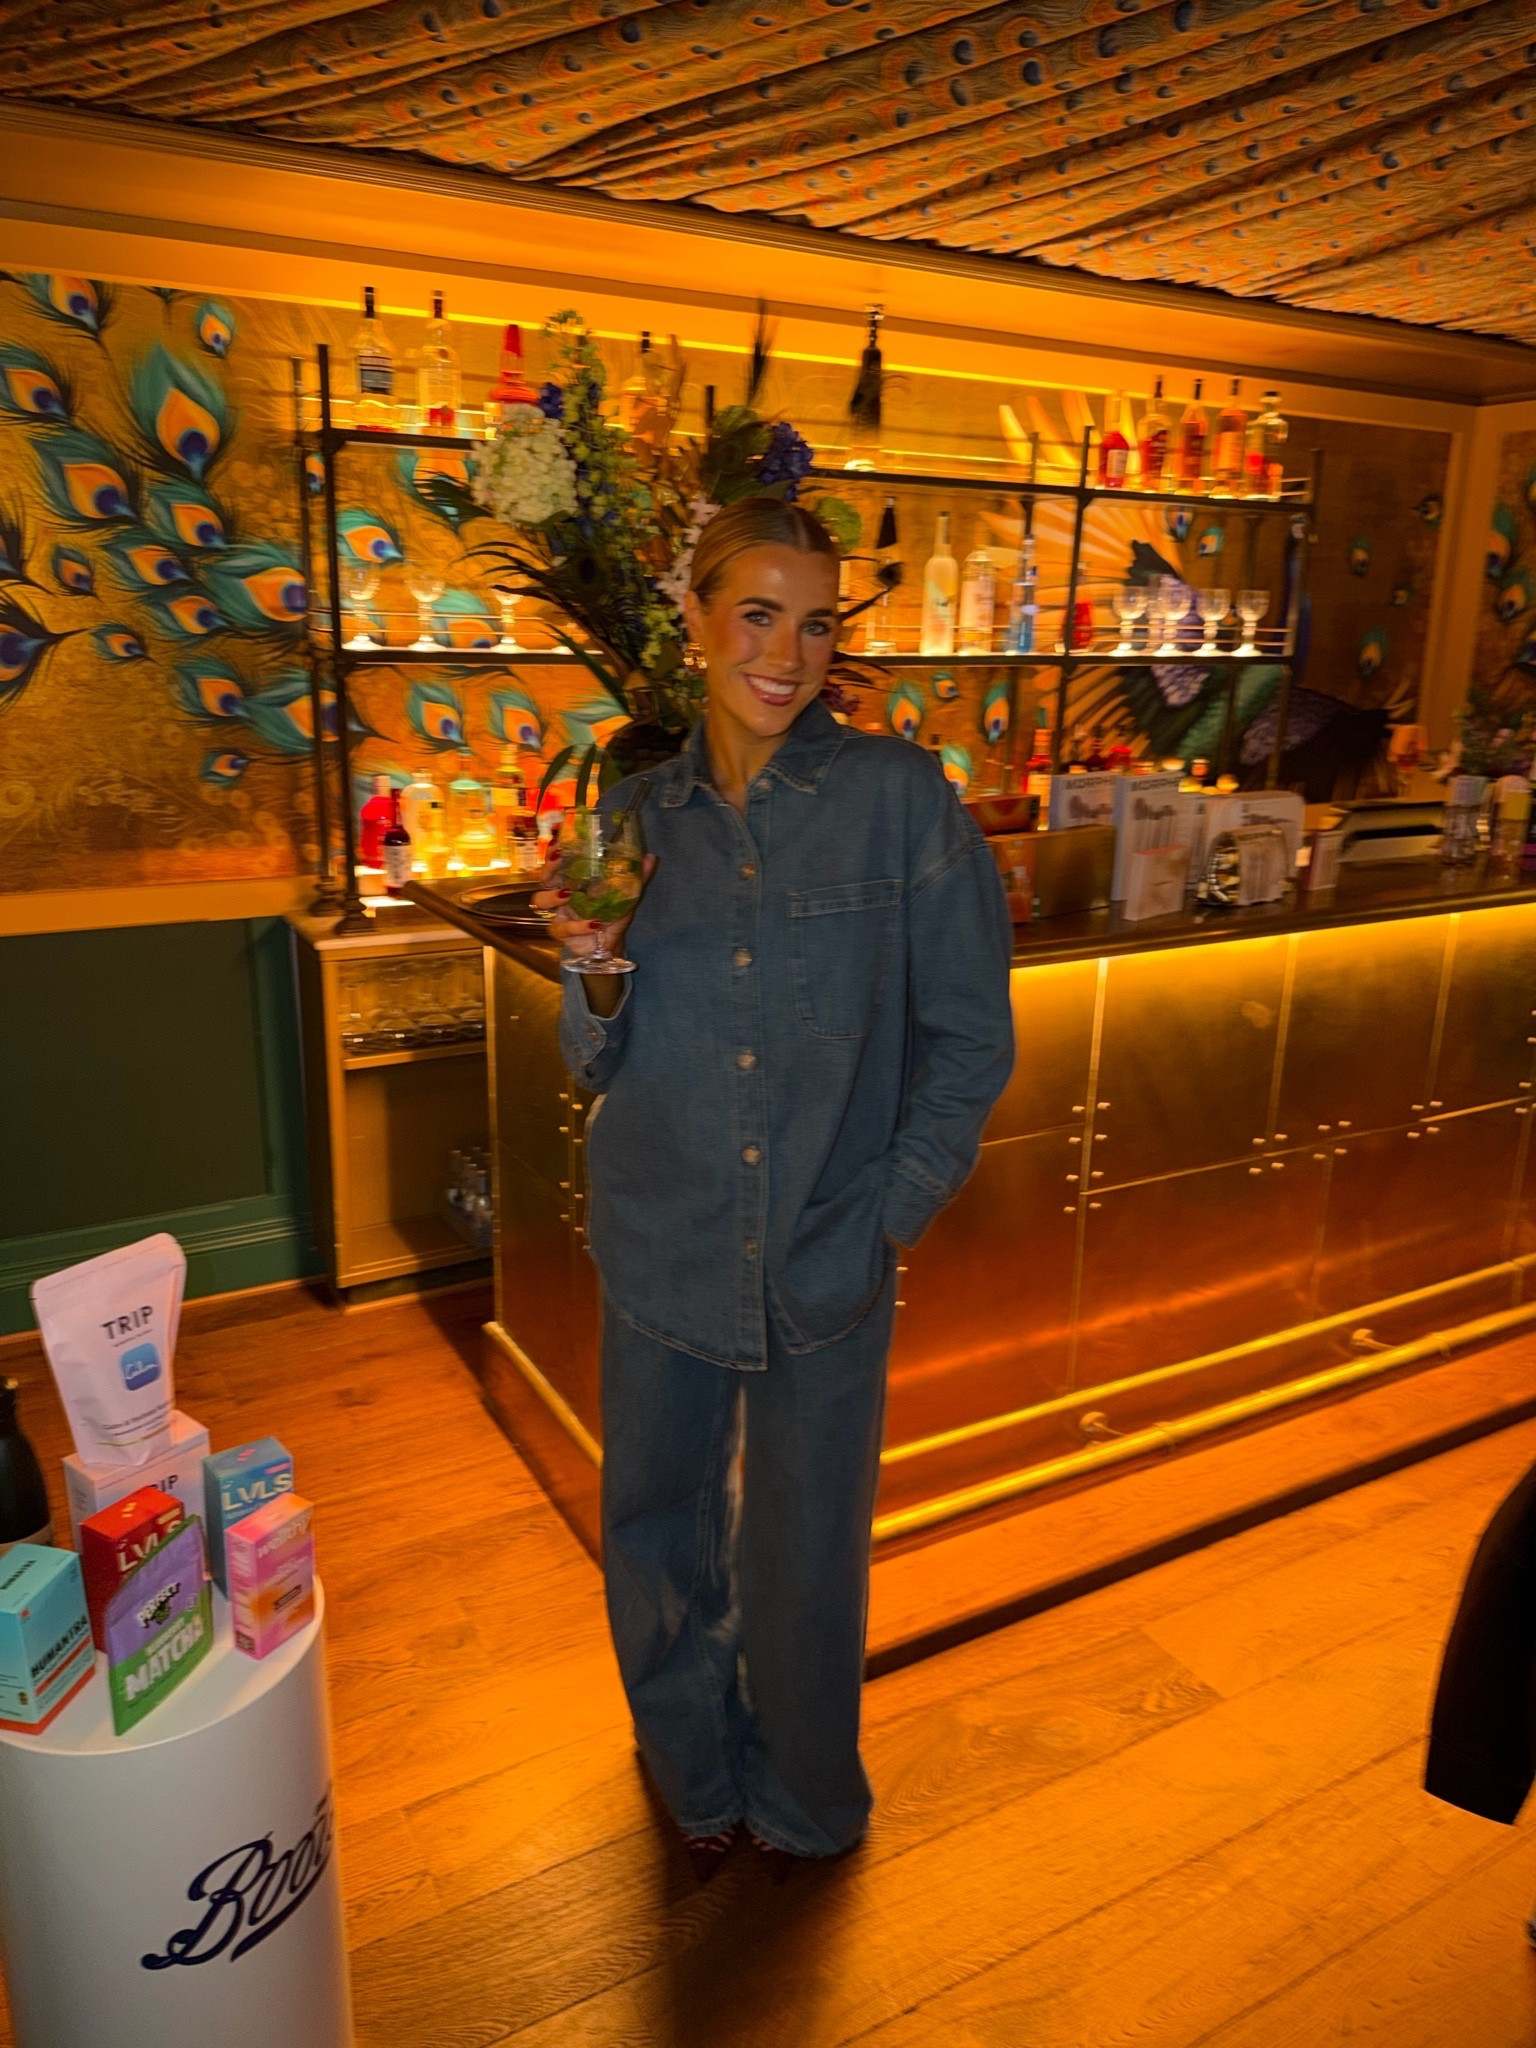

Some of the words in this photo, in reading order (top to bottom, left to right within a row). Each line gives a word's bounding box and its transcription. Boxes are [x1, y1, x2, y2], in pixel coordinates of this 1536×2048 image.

[102, 1305, 153, 1339] TRIP
[221, 1473, 293, 1511] LVLS
[31, 1614, 89, 1678] HUMANTRA
[125, 1614, 204, 1701] MATCHA
